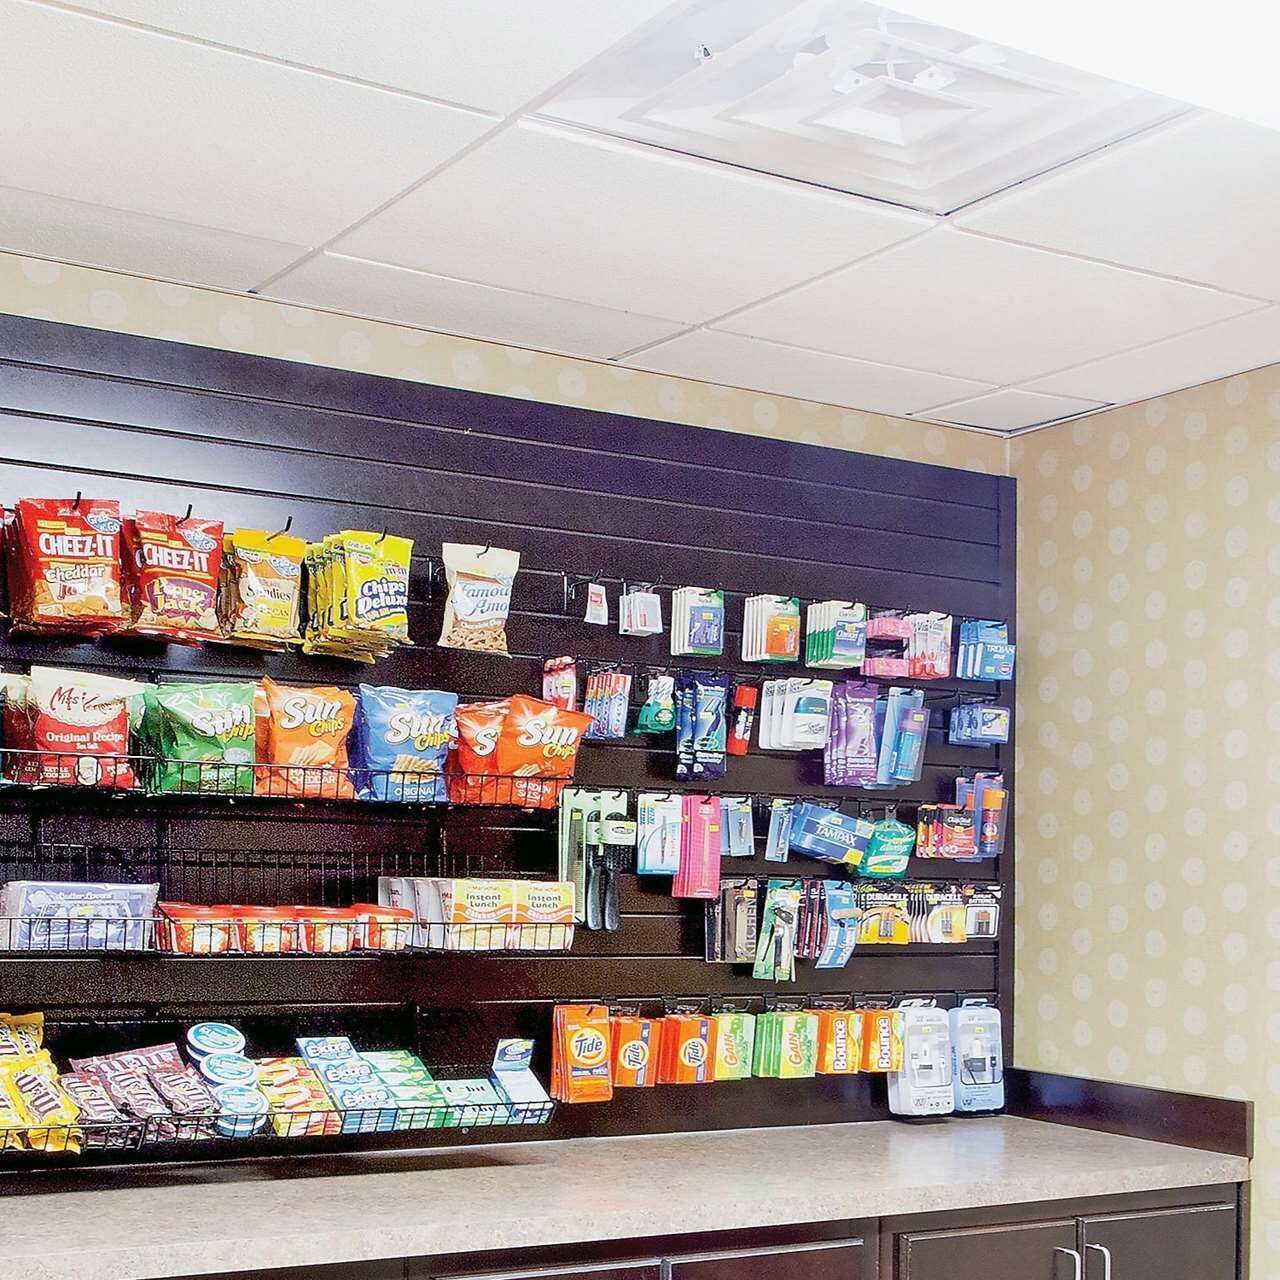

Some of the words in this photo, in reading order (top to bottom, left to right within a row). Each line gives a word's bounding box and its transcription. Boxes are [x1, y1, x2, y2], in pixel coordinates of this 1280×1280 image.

[39, 534, 113, 558] CHEEZ-IT
[144, 544, 209, 573] CHEEZ-IT
[362, 579, 405, 597] Chips
[154, 597, 205, 615] Jack
[465, 599, 507, 617] Amo
[192, 704, 250, 736] Sun
[281, 697, 341, 728] Sun
[46, 732, 90, 744] Original
[308, 717, 345, 737] Chips
[386, 712, 443, 743] Sun
[518, 719, 579, 746] Sun
[414, 731, 450, 751] Chips
[542, 743, 576, 760] Chip
[816, 824, 858, 848] TAMPAX
[574, 1033, 604, 1058] Tide
[627, 1043, 642, 1067] Tide
[686, 1041, 701, 1065] Tide
[723, 1033, 738, 1067] GAIN
[788, 1033, 802, 1066] GAIN
[833, 1019, 848, 1070] Bounce
[877, 1018, 892, 1069] Bounce
